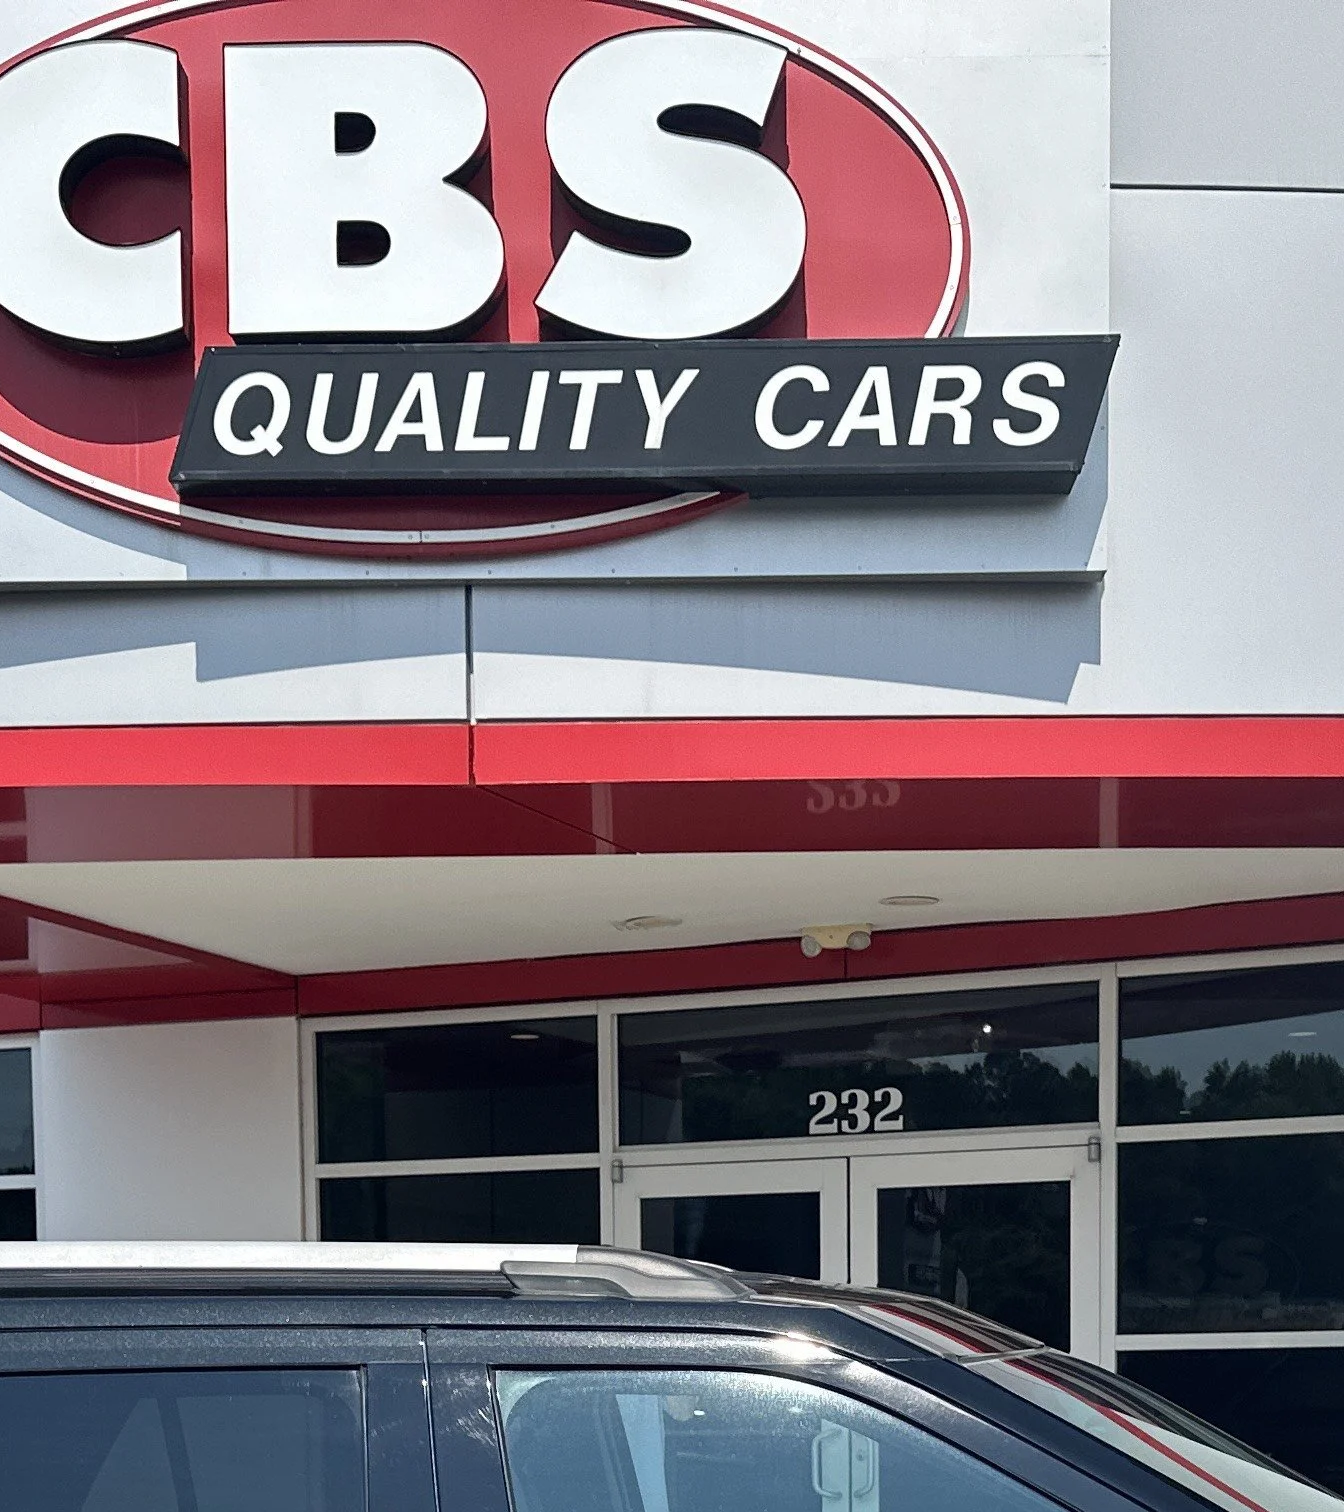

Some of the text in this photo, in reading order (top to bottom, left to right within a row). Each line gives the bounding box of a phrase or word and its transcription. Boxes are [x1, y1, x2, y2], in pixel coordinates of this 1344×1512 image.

[212, 361, 1068, 458] QUALITY CARS
[808, 1086, 904, 1135] 232
